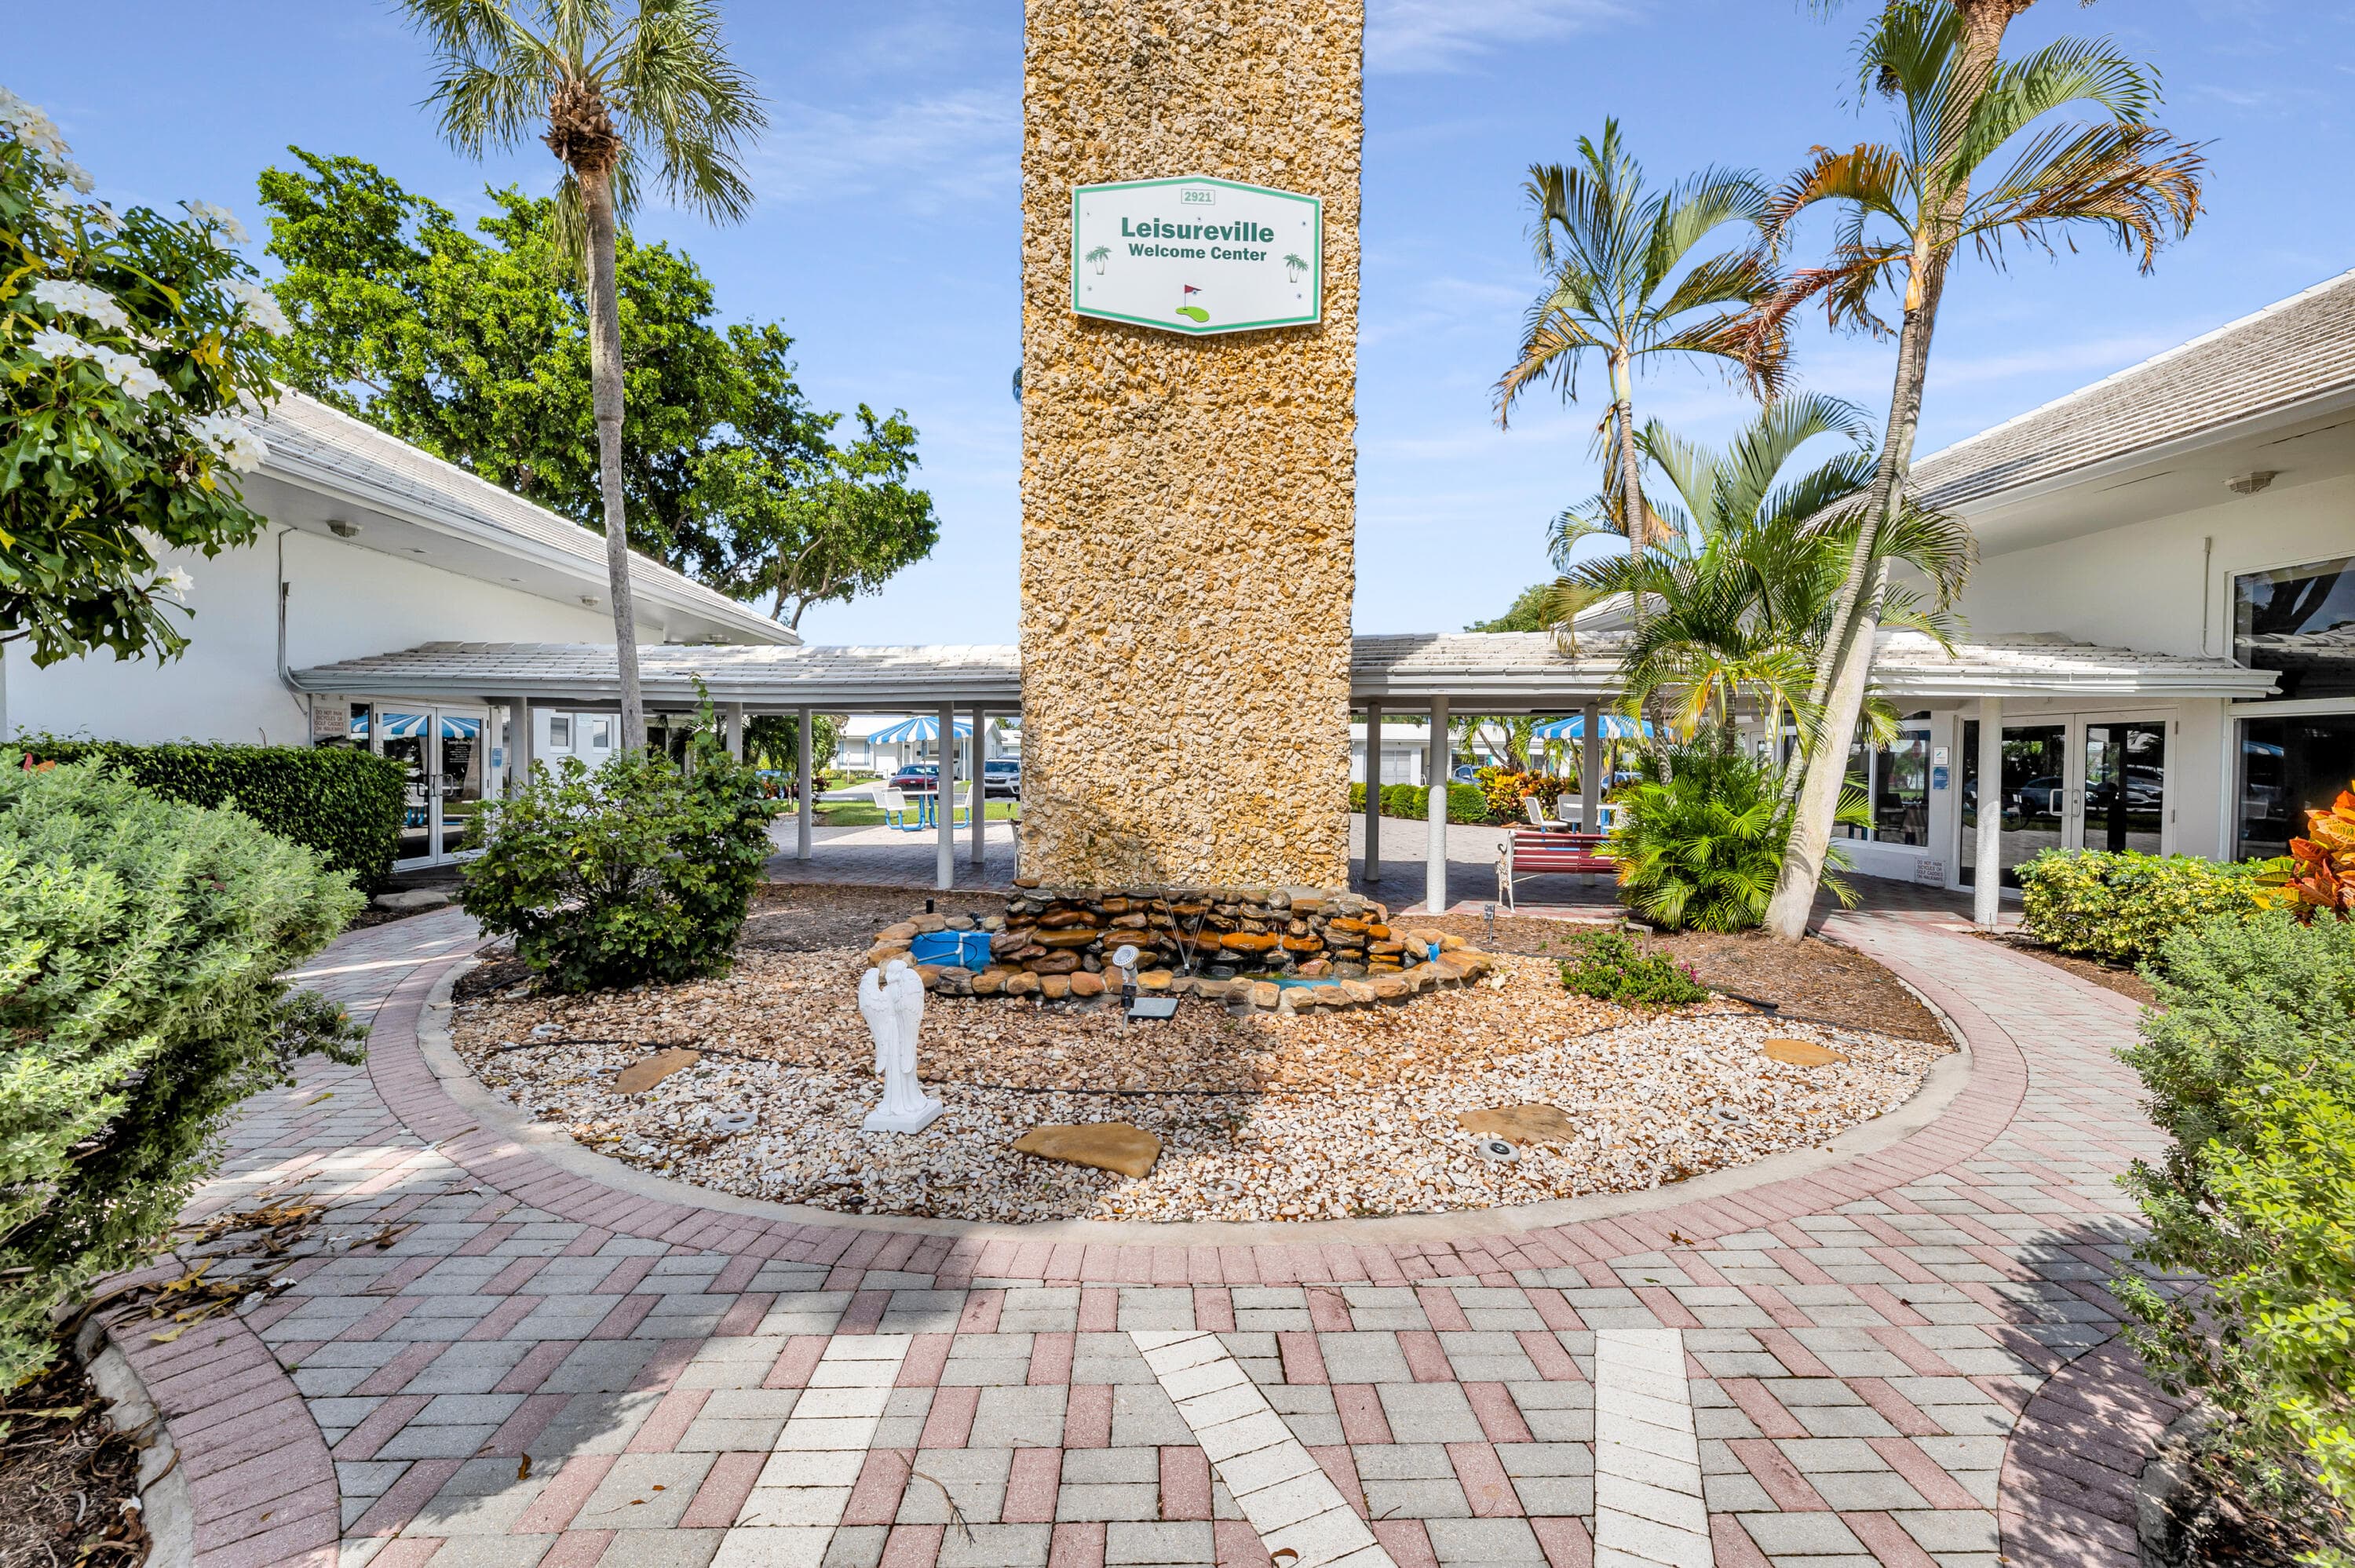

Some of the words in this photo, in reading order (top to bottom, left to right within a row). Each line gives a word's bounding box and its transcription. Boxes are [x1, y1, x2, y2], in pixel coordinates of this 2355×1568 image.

[1184, 191, 1212, 202] 2921
[1122, 217, 1274, 242] Leisureville
[1129, 243, 1206, 259] Welcome
[1210, 246, 1267, 261] Center
